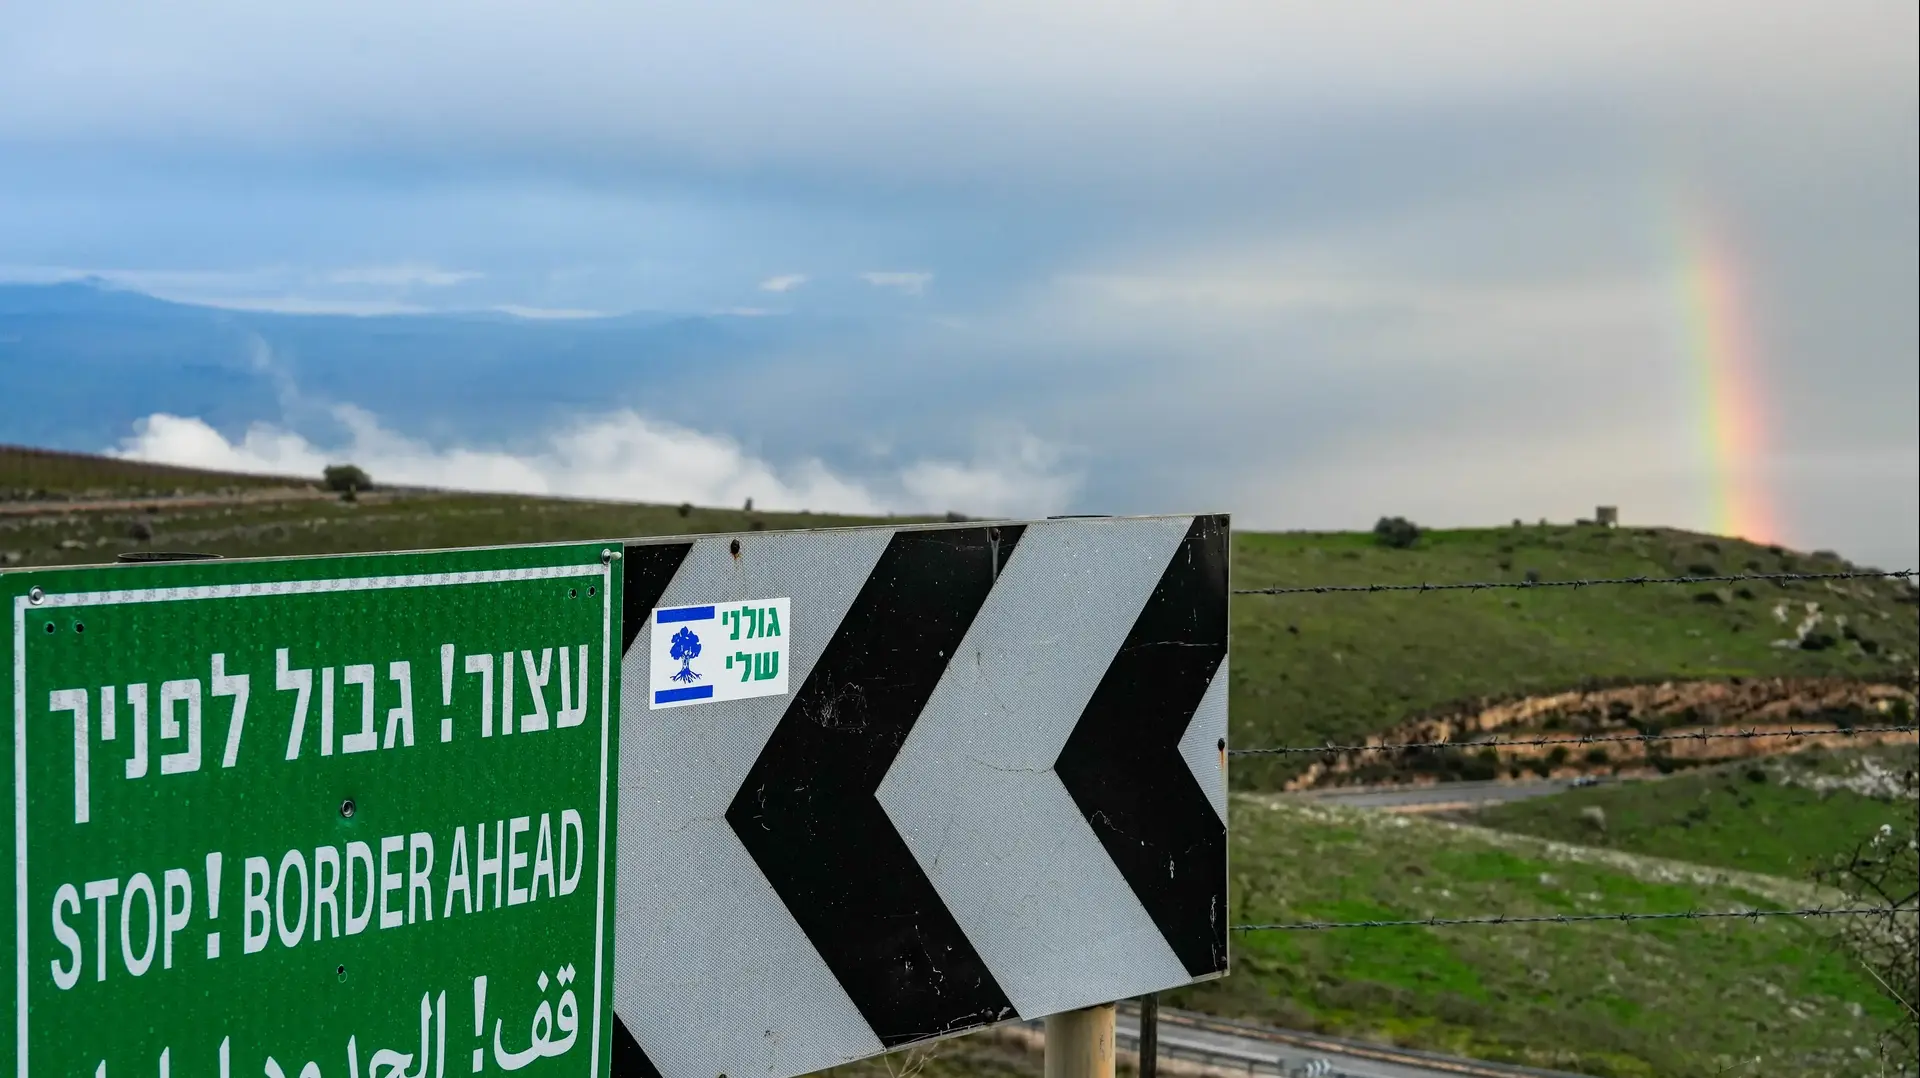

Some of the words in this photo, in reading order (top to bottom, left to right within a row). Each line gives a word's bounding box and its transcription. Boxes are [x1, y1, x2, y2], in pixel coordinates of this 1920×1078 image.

[721, 605, 781, 641] גולני
[725, 650, 779, 683] שלי
[48, 653, 250, 824] לפניך
[275, 647, 415, 761] גבול
[440, 643, 589, 743] עצור!
[51, 851, 223, 990] STOP!
[243, 831, 434, 955] BORDER
[443, 808, 584, 918] AHEAD
[472, 962, 579, 1074] قف!
